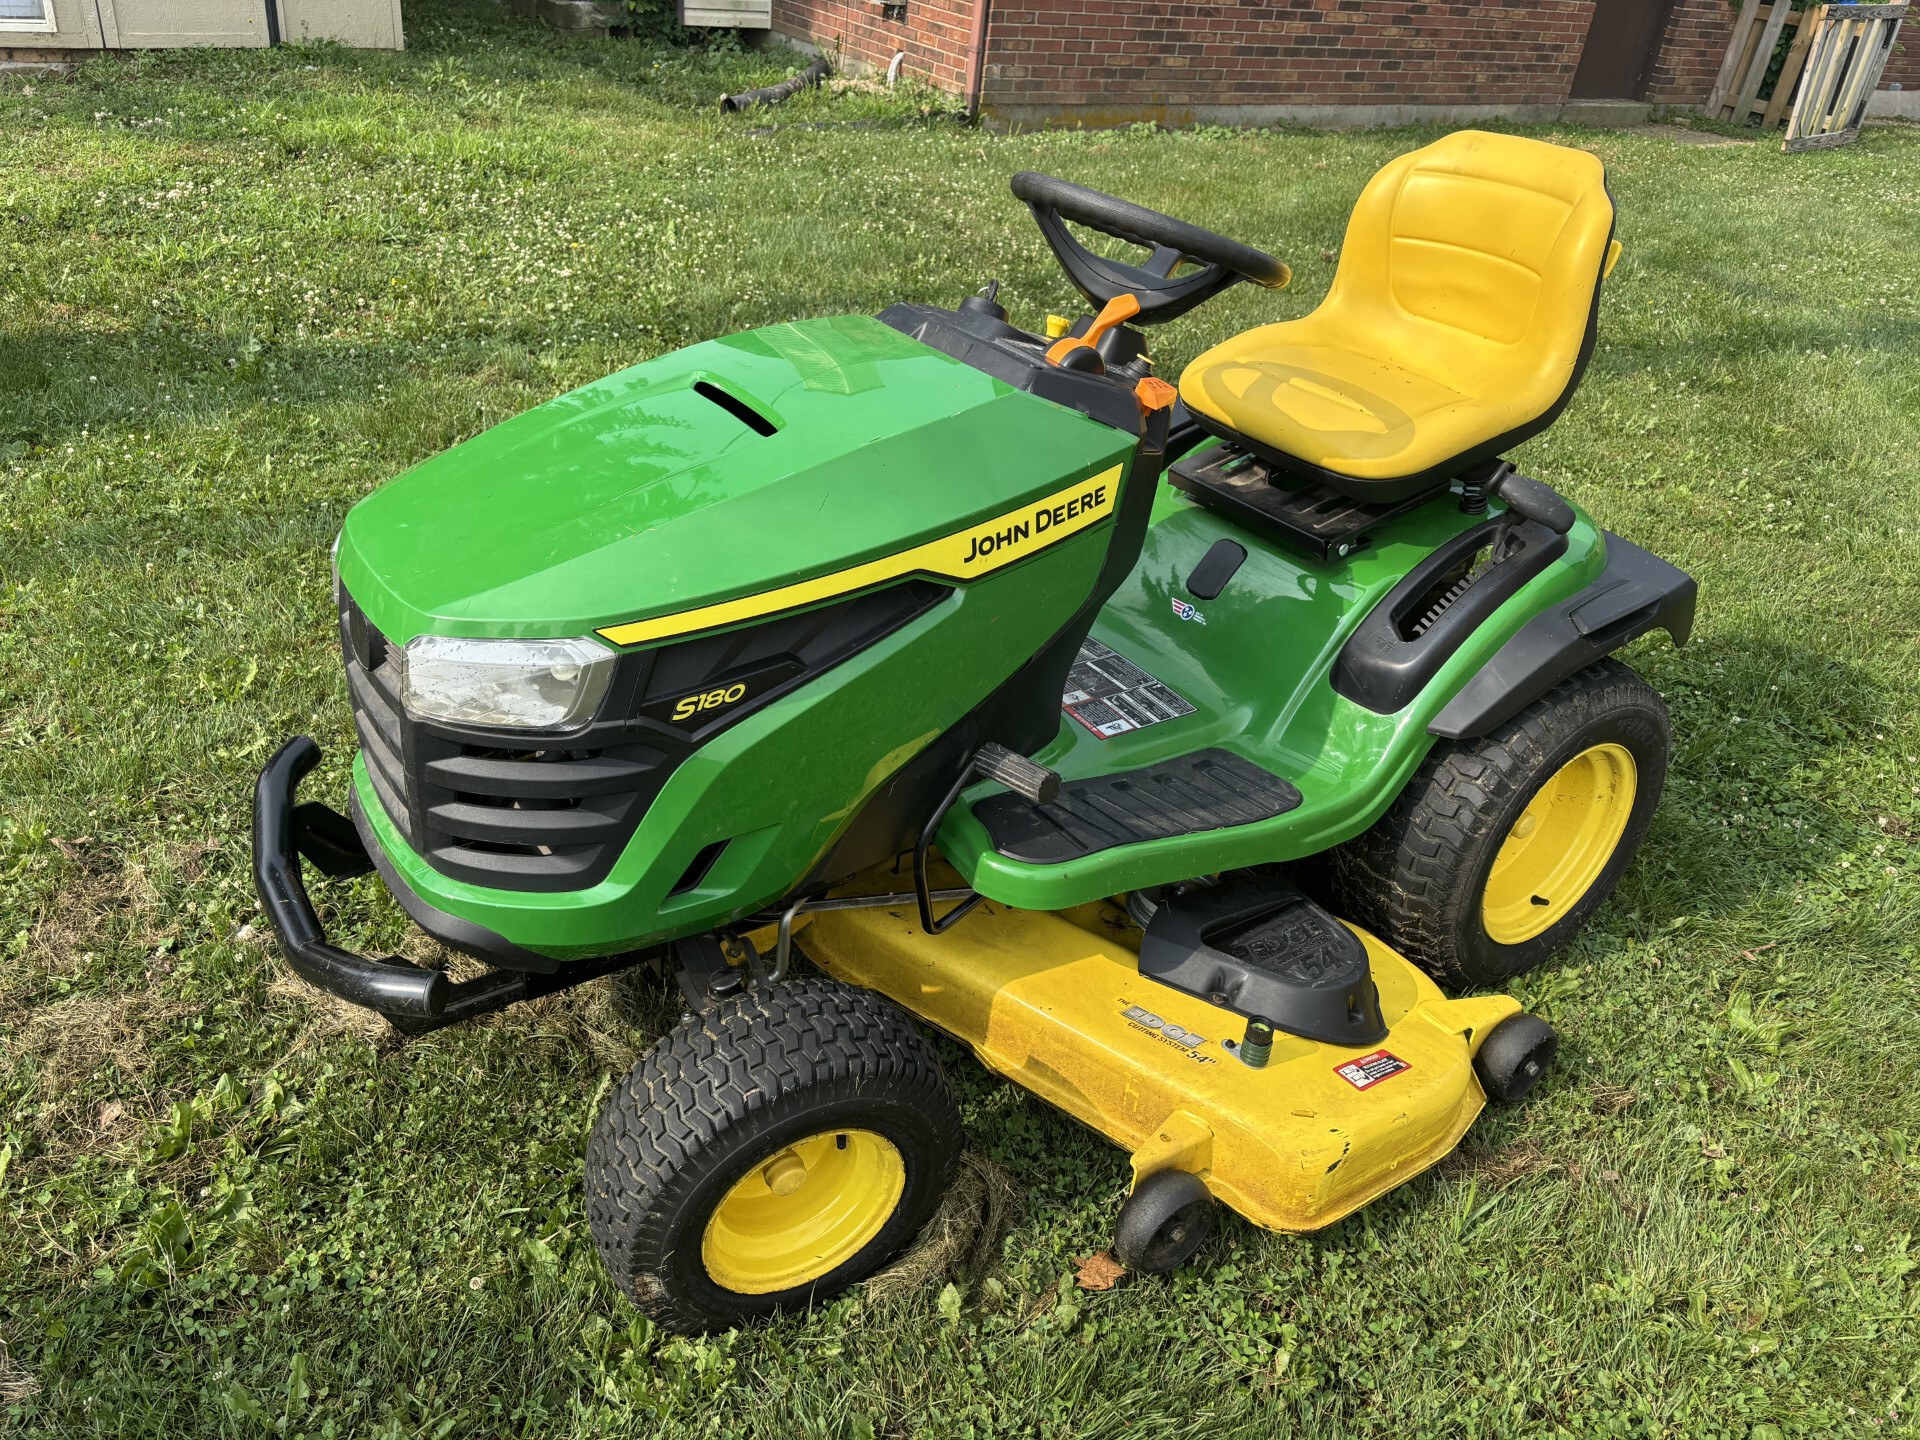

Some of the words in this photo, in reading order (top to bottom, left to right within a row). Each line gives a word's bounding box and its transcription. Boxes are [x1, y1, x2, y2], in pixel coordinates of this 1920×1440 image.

[964, 520, 1029, 563] JOHN
[1035, 485, 1106, 534] DEERE
[671, 683, 746, 721] S180
[1248, 917, 1324, 962] EDGE
[1117, 998, 1132, 1006] THE
[1119, 1005, 1208, 1049] EDGE
[1127, 1021, 1159, 1039] CUTTING
[1158, 1036, 1188, 1054] SYSTEM
[1186, 1050, 1217, 1064] 54"
